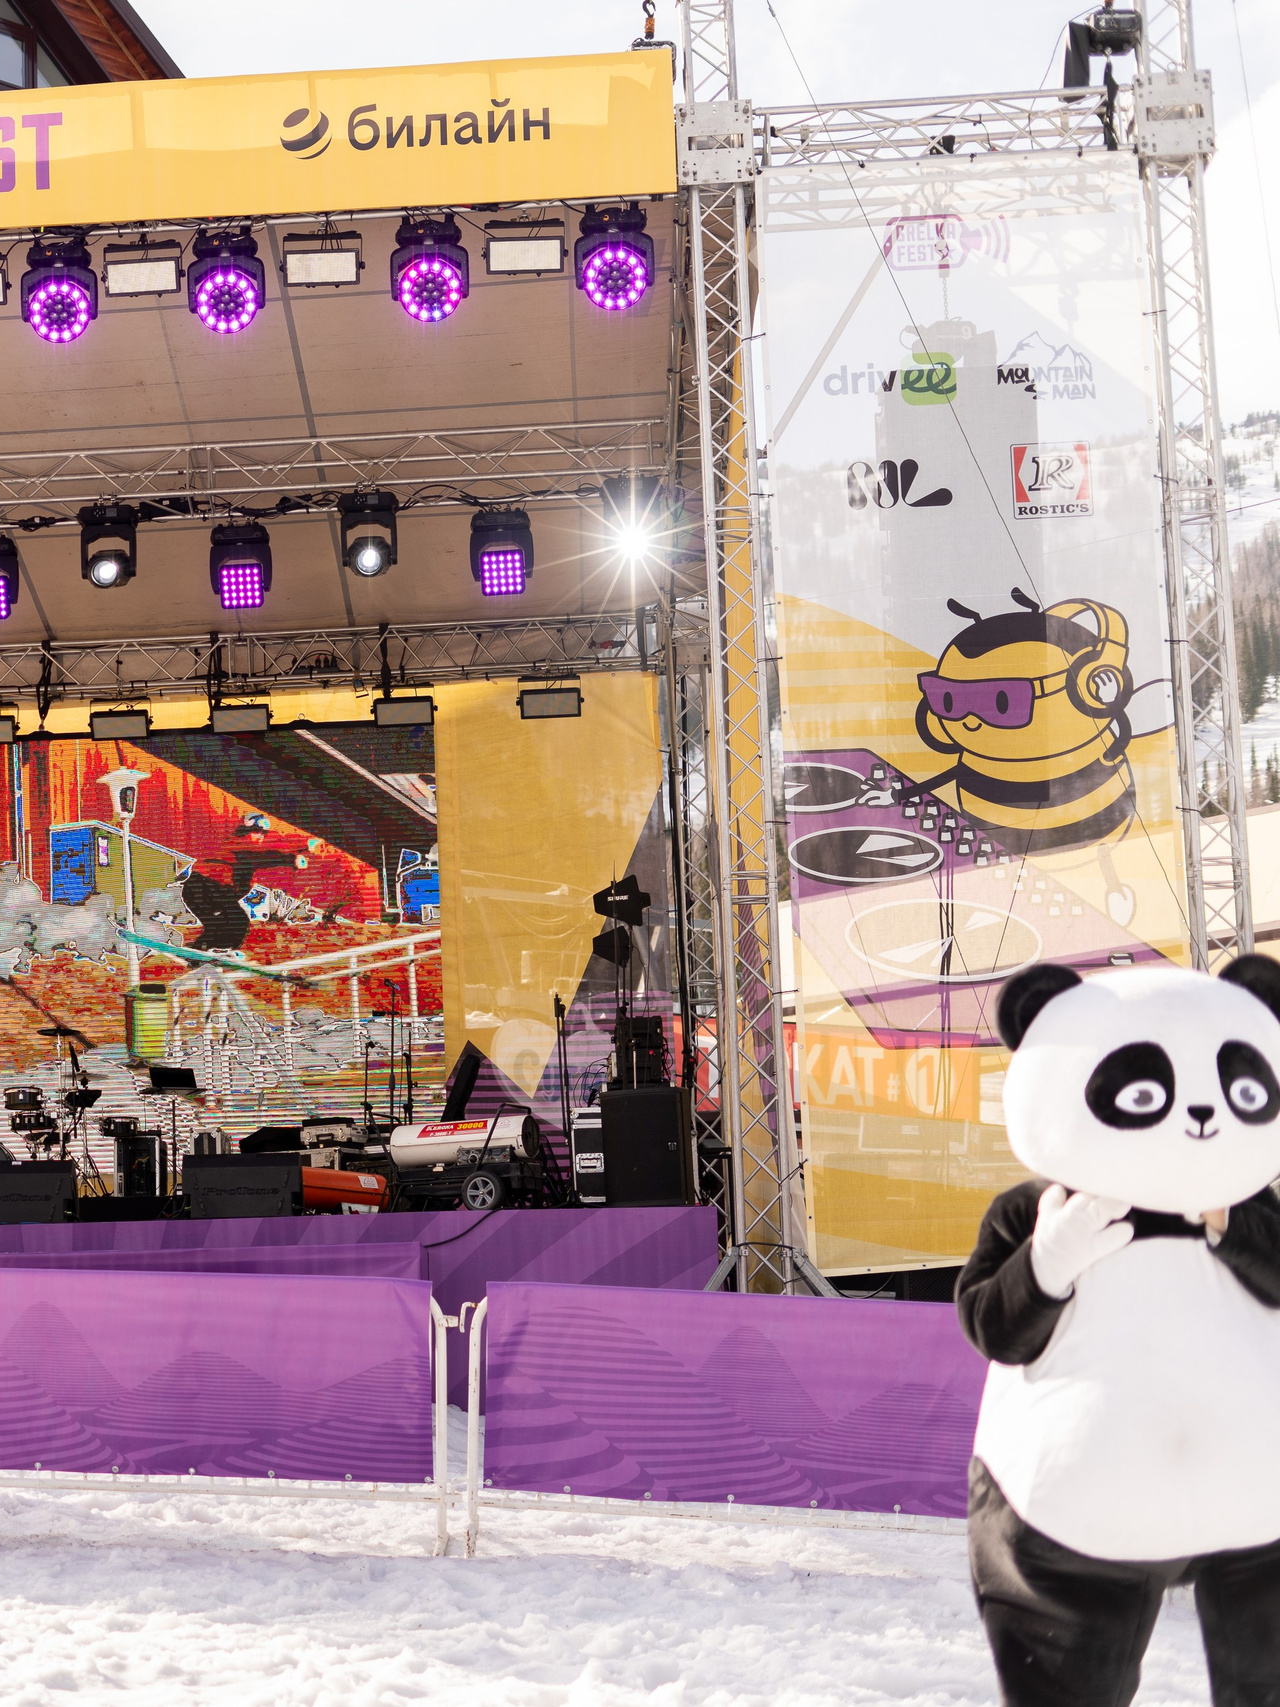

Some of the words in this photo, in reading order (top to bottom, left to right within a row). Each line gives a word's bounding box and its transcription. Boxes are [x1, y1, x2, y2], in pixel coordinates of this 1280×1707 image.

[348, 98, 552, 152] билайн
[896, 222, 956, 243] GRELKA
[897, 244, 936, 263] FEST
[823, 361, 957, 397] drivee
[996, 363, 1094, 386] MOUNTAIN
[1052, 382, 1097, 400] MAN
[1017, 503, 1090, 516] ROSTIC'S
[456, 1122, 484, 1130] 30000
